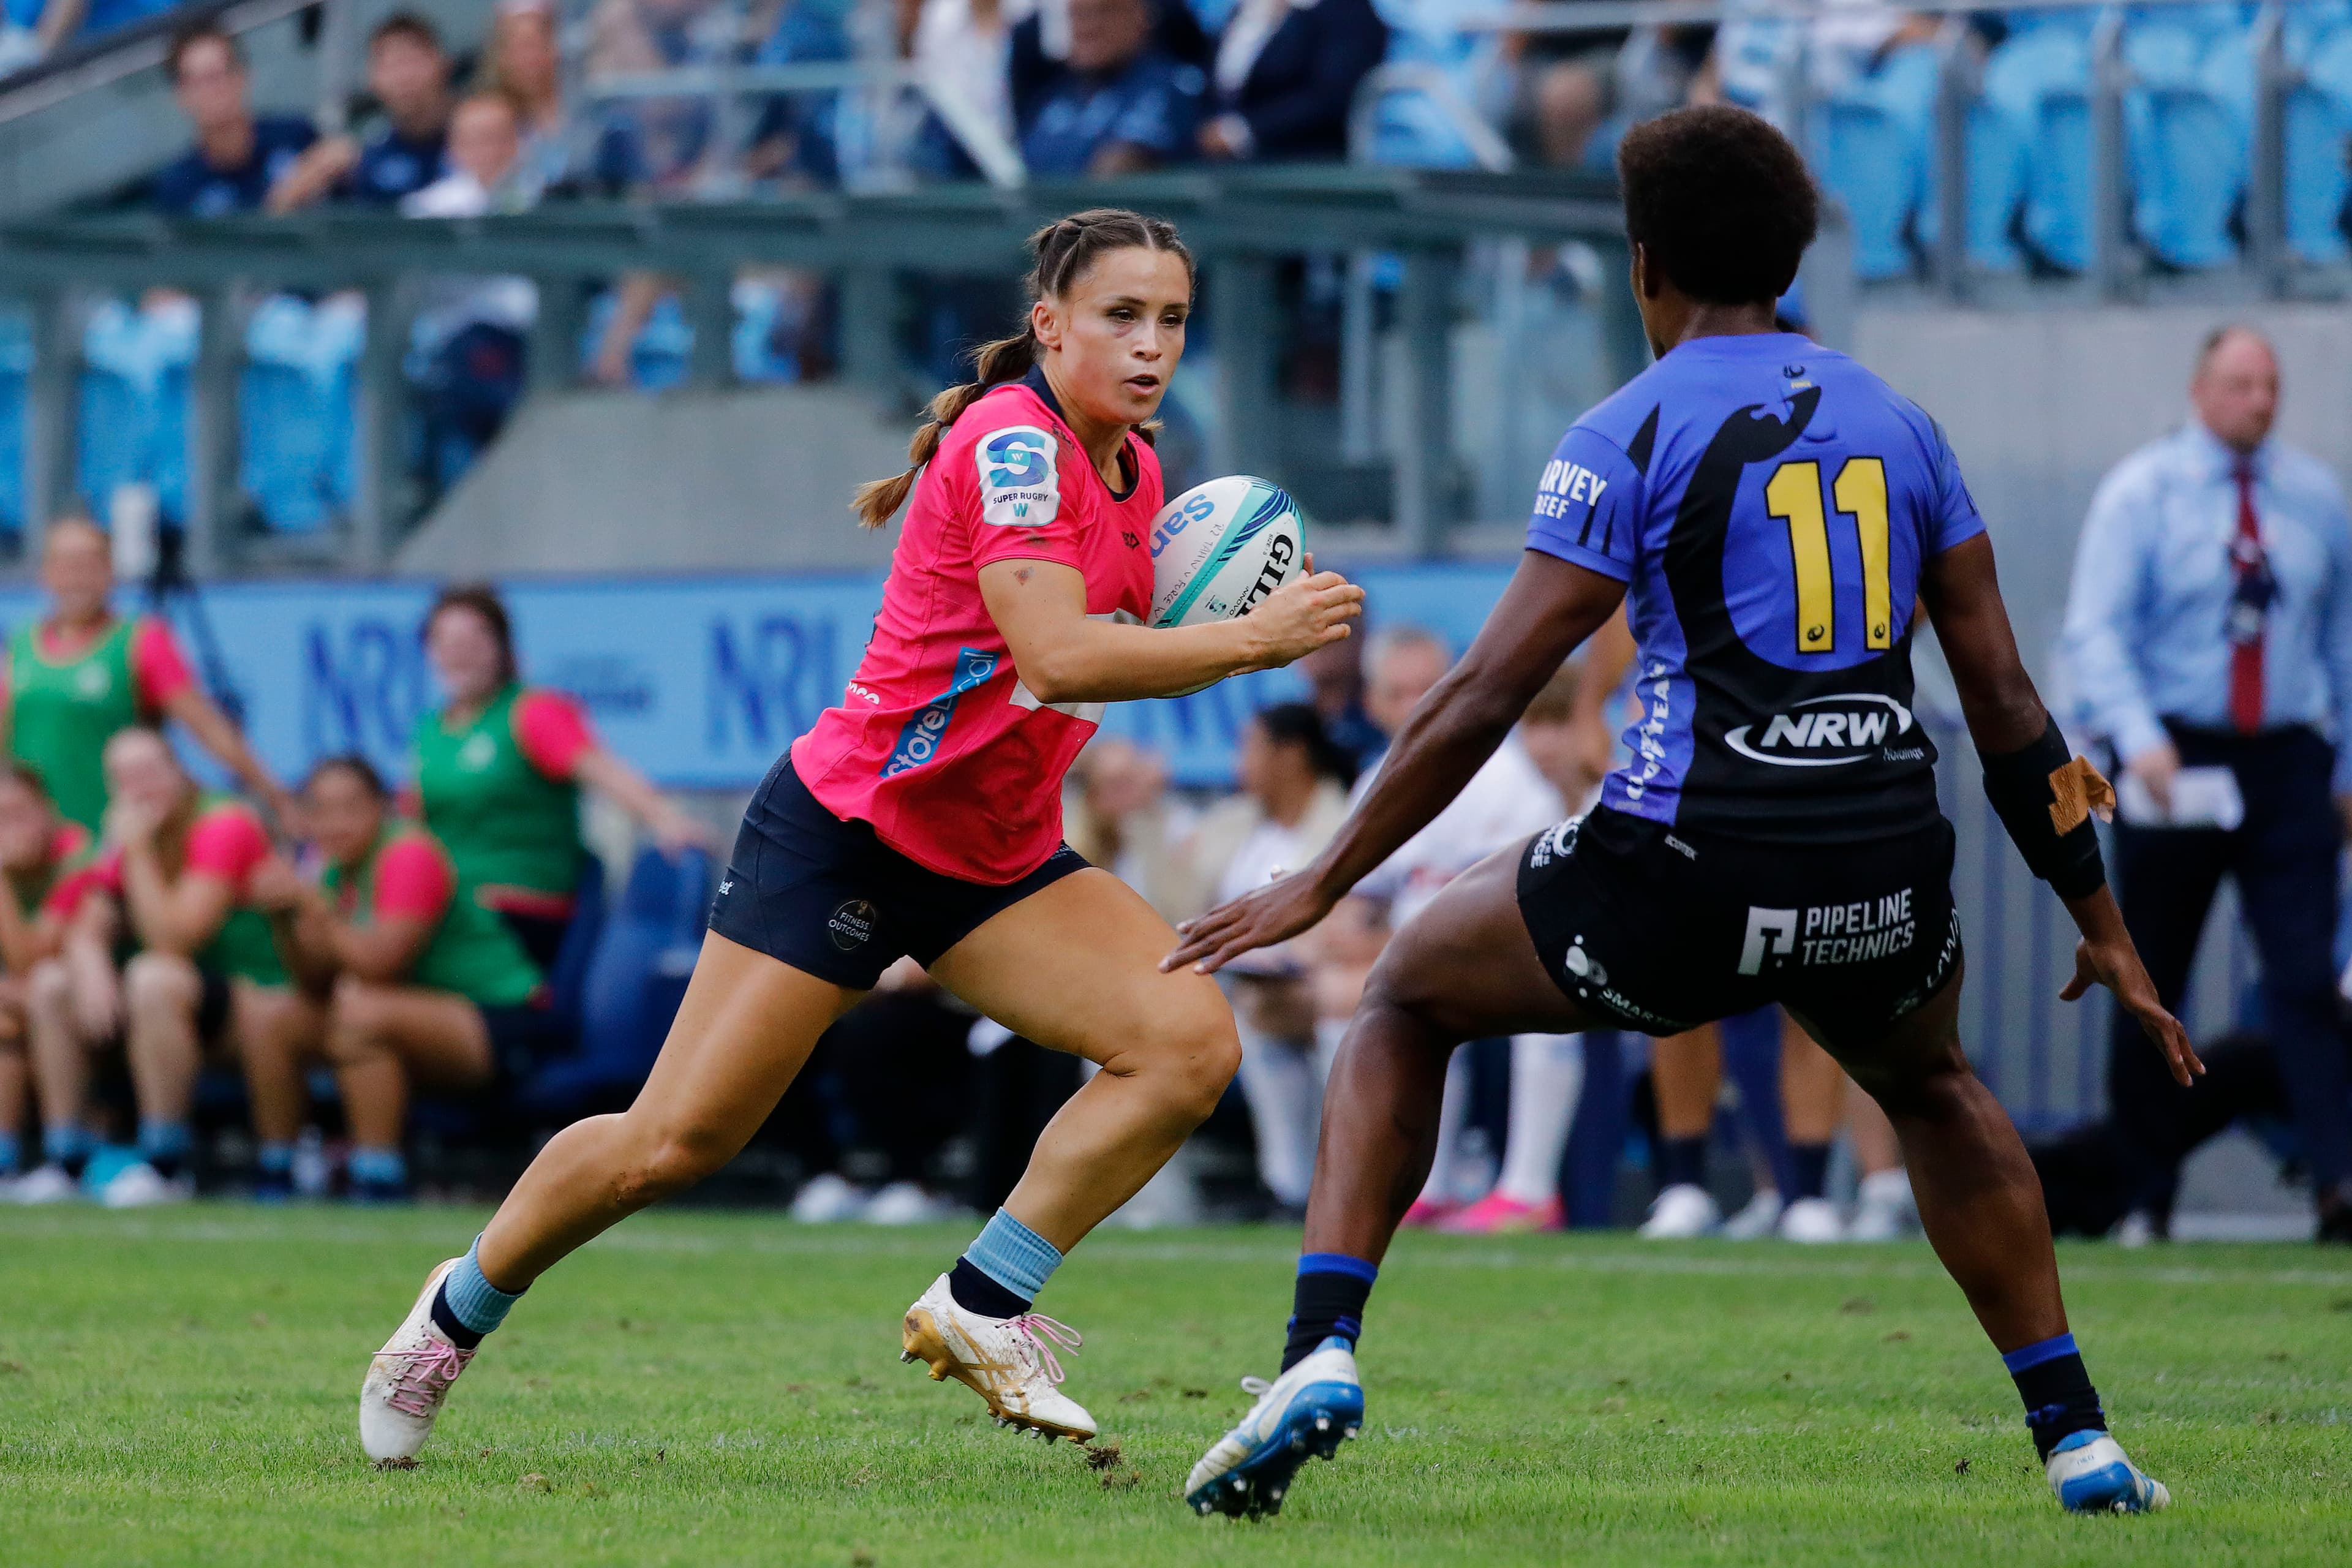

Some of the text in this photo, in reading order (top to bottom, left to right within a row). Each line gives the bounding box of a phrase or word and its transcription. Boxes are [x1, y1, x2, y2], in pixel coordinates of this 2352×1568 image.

[993, 492, 1049, 505] SUPER RUGBY
[1012, 503, 1029, 518] W
[1150, 494, 1215, 568] San
[1765, 456, 1891, 654] 11
[1163, 580, 1186, 605] FORCE
[1760, 712, 1889, 748] NRW
[840, 912, 870, 930] FITNESS
[1805, 888, 1912, 937] PIPELINE
[828, 919, 870, 941] OUTCOMES
[1803, 920, 1915, 966] TECHNICS
